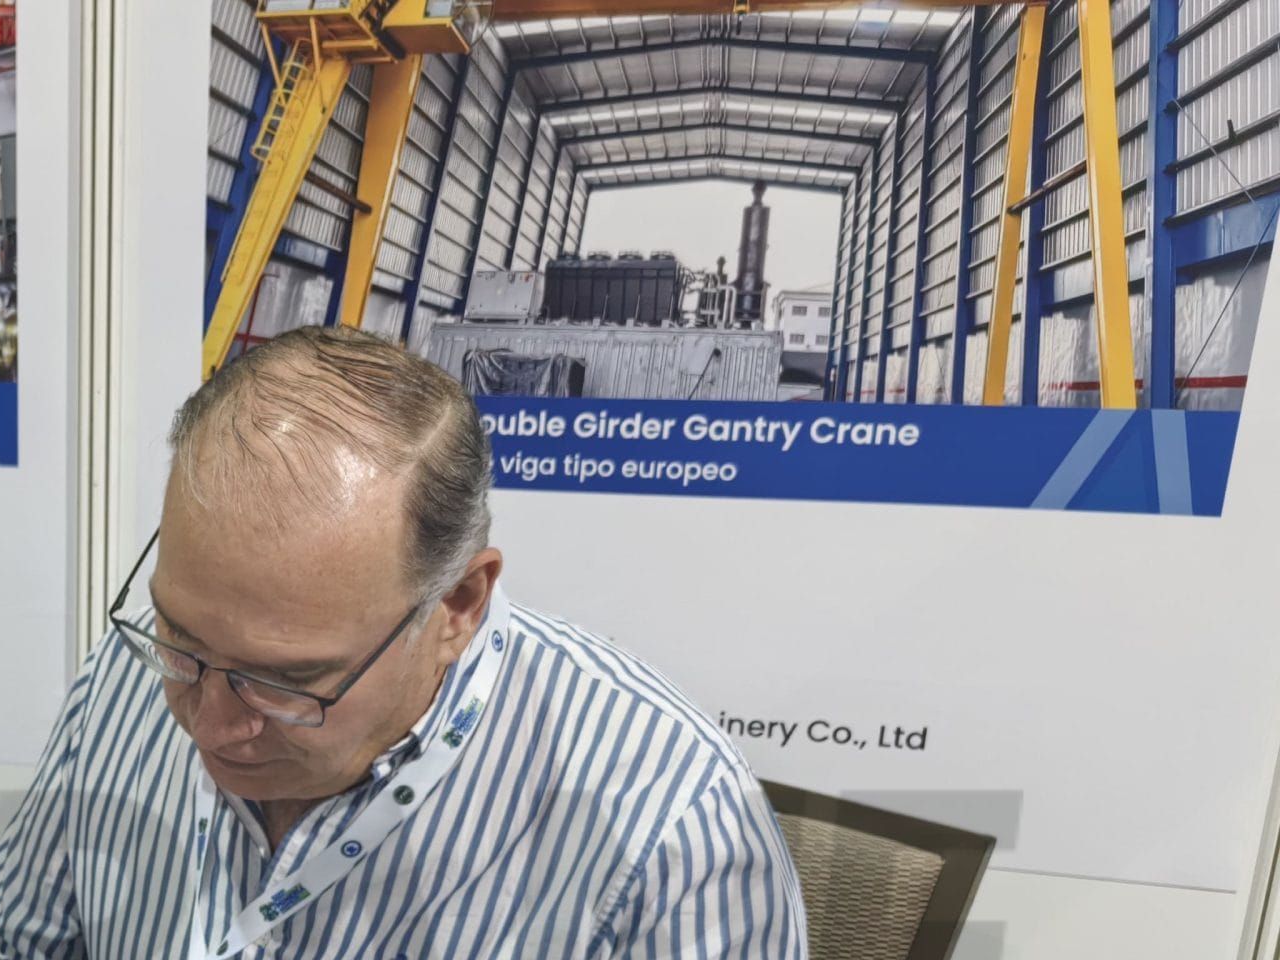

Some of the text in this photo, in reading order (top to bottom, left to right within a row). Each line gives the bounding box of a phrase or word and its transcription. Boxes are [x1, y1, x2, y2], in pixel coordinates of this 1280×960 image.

[574, 412, 675, 441] Girder
[682, 415, 801, 450] Gantry
[810, 416, 919, 447] Crane
[501, 455, 556, 481] viga
[563, 453, 615, 482] tipo
[621, 460, 737, 487] europeo
[807, 718, 866, 748] Co.,
[878, 724, 928, 751] Ltd
